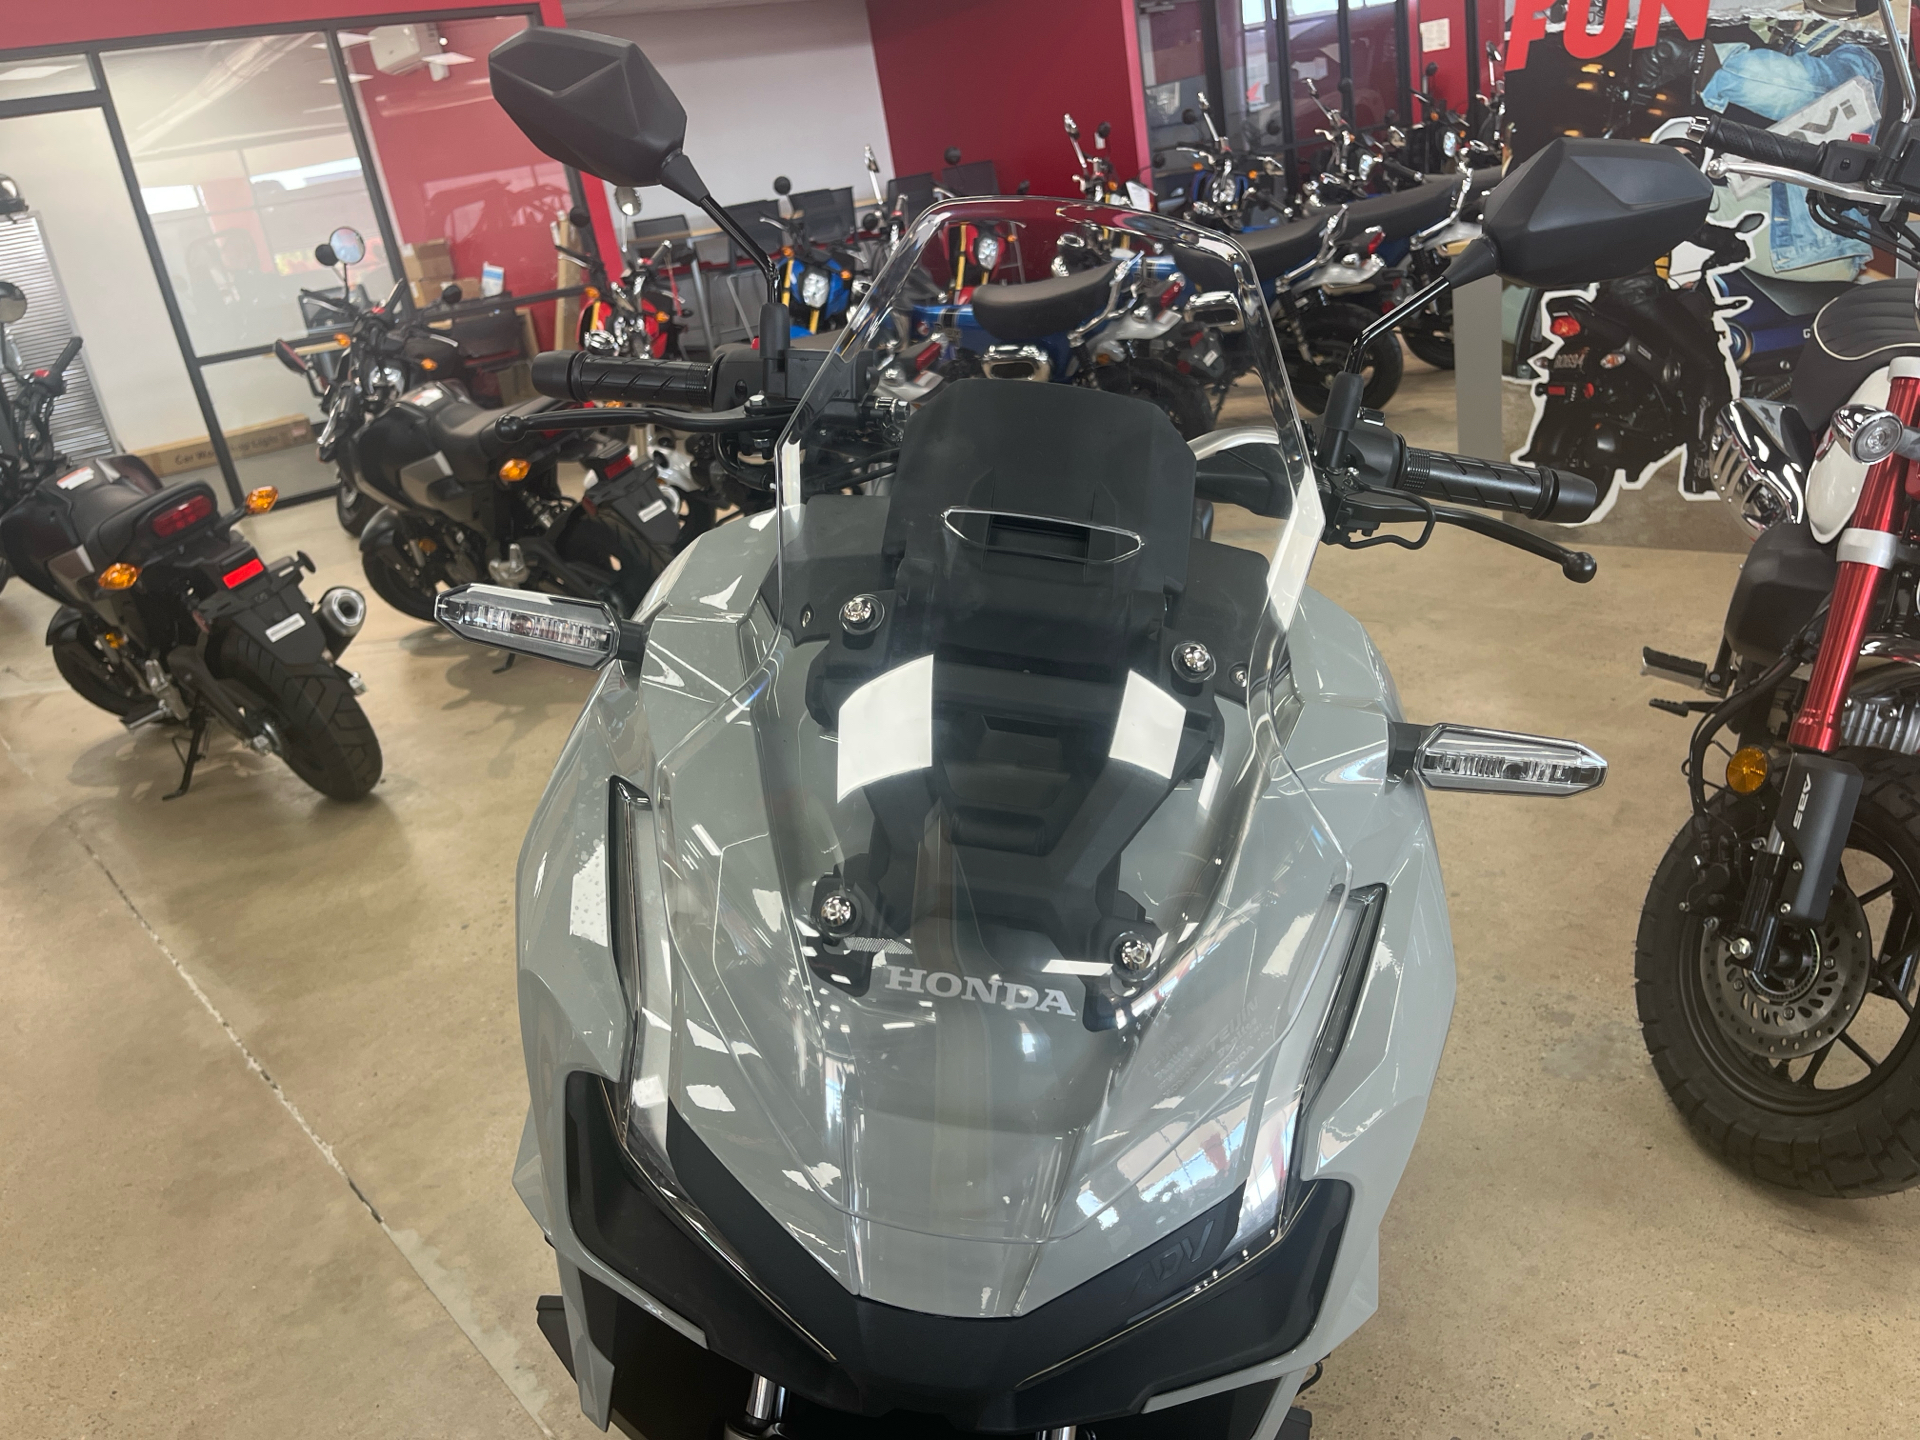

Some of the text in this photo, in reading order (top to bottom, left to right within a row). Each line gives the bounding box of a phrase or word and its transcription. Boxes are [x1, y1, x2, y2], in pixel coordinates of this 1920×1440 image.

[1505, 0, 1709, 72] FUN
[1793, 773, 1811, 830] ABS
[884, 965, 1077, 1017] HONDA
